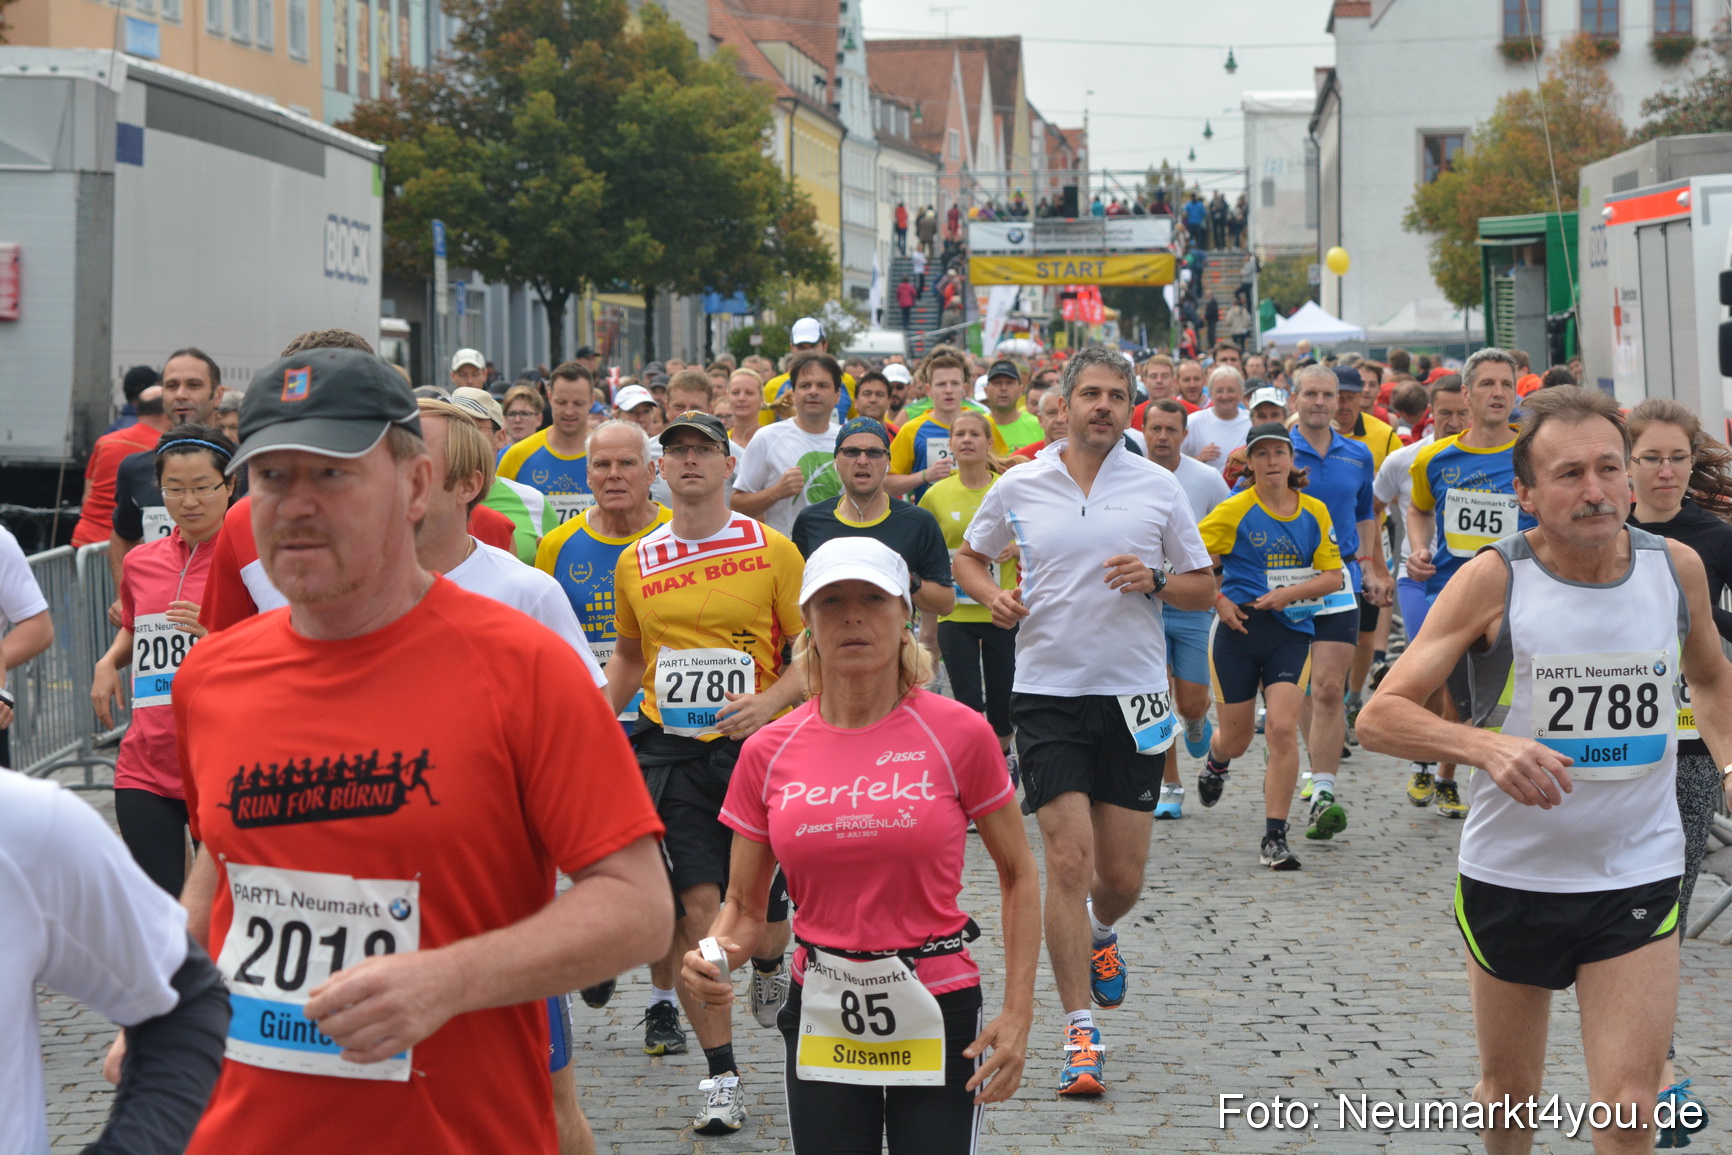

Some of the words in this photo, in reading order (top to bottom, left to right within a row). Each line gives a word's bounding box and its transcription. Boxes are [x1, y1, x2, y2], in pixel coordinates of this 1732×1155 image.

[1036, 261, 1107, 278] START
[1447, 495, 1469, 504] PARTL
[1471, 499, 1506, 507] Neumarkt
[1458, 507, 1503, 534] 645
[641, 570, 698, 599] MAX
[704, 556, 771, 581] BÖGL
[659, 658, 690, 668] PARTL
[691, 657, 737, 666] Neumarkt
[1536, 667, 1583, 680] PARTL
[1585, 664, 1649, 678] Neumarkt
[666, 670, 745, 703] 2780
[1547, 682, 1659, 732] 2788
[1580, 743, 1628, 763] Josef
[238, 793, 281, 820] RUN
[287, 785, 326, 818] FOR
[329, 781, 397, 811] BÜRNI
[779, 769, 936, 811] Perfekt
[835, 818, 918, 831] FRAUENLAUF
[234, 882, 286, 907] PARTL
[291, 891, 381, 918] Neumarkt
[843, 970, 908, 987] Neumarkt
[840, 989, 896, 1037] 85
[833, 1043, 912, 1066] Susanne
